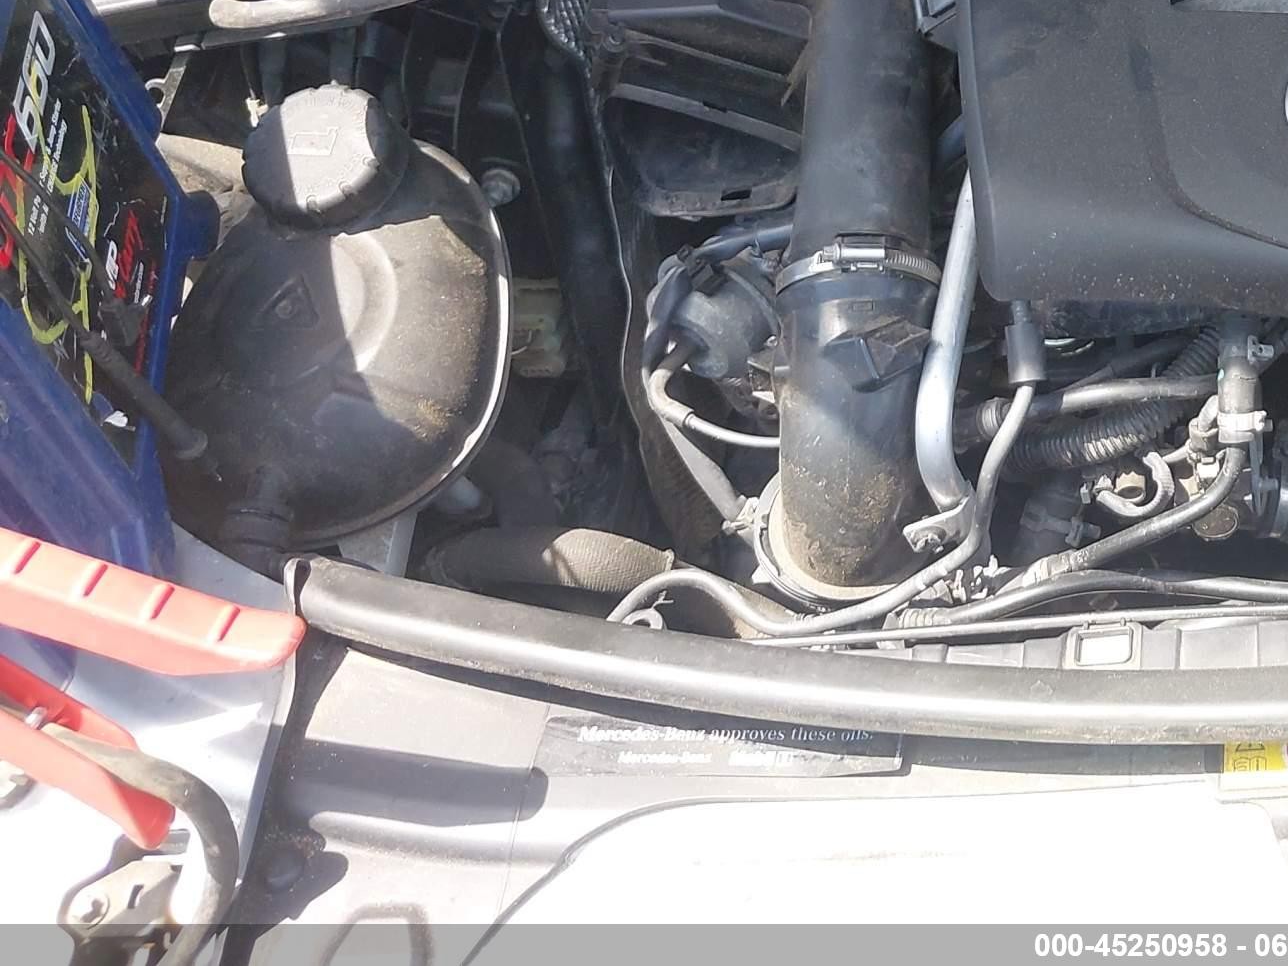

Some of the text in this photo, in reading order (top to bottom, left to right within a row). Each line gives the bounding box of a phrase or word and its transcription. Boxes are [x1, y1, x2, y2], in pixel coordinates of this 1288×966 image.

[577, 726, 706, 743] Mercedes-Benz
[709, 728, 785, 747] approves
[790, 726, 836, 741] these
